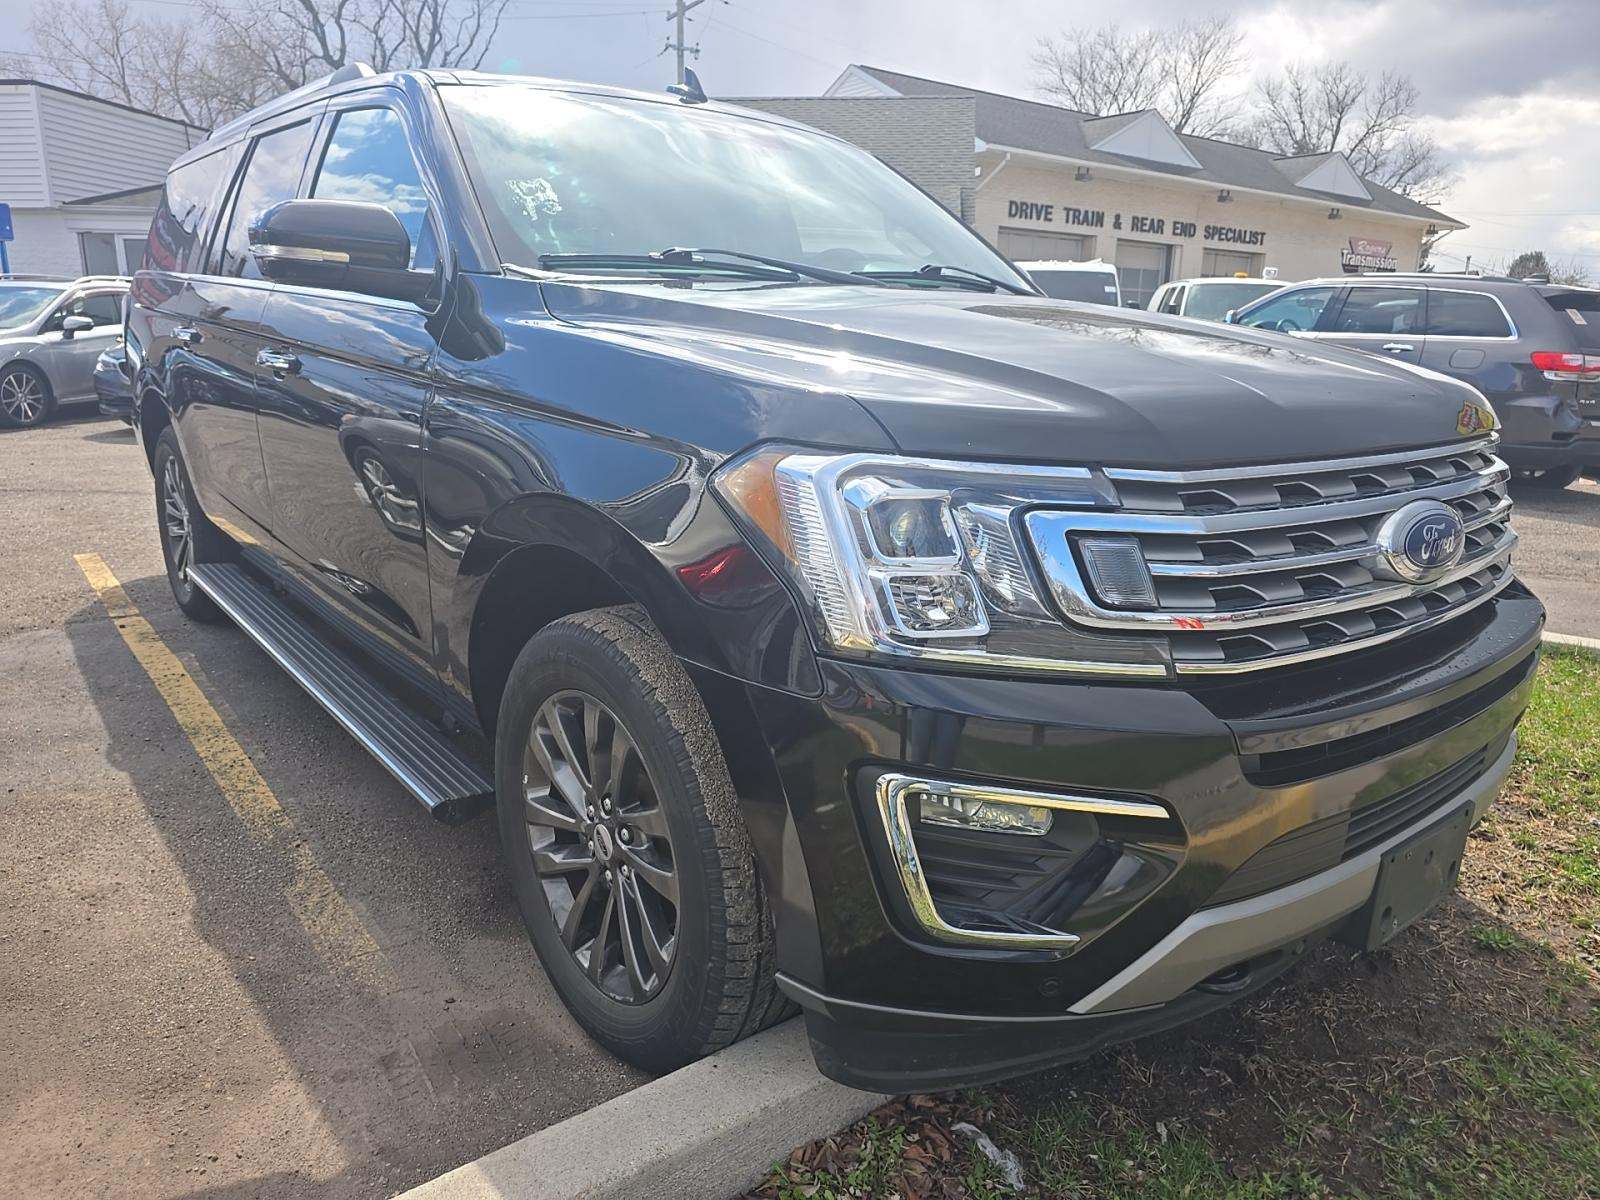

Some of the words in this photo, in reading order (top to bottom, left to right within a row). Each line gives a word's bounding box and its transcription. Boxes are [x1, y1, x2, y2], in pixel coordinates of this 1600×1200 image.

[1008, 200, 1054, 222] DRIVE
[1063, 206, 1105, 228] TRAIN
[1113, 213, 1123, 230] &
[1131, 215, 1165, 235] REAR
[1172, 221, 1197, 238] END
[1203, 224, 1267, 246] SPECIALIST
[1342, 249, 1398, 269] Transmission
[1422, 523, 1455, 561] Ford
